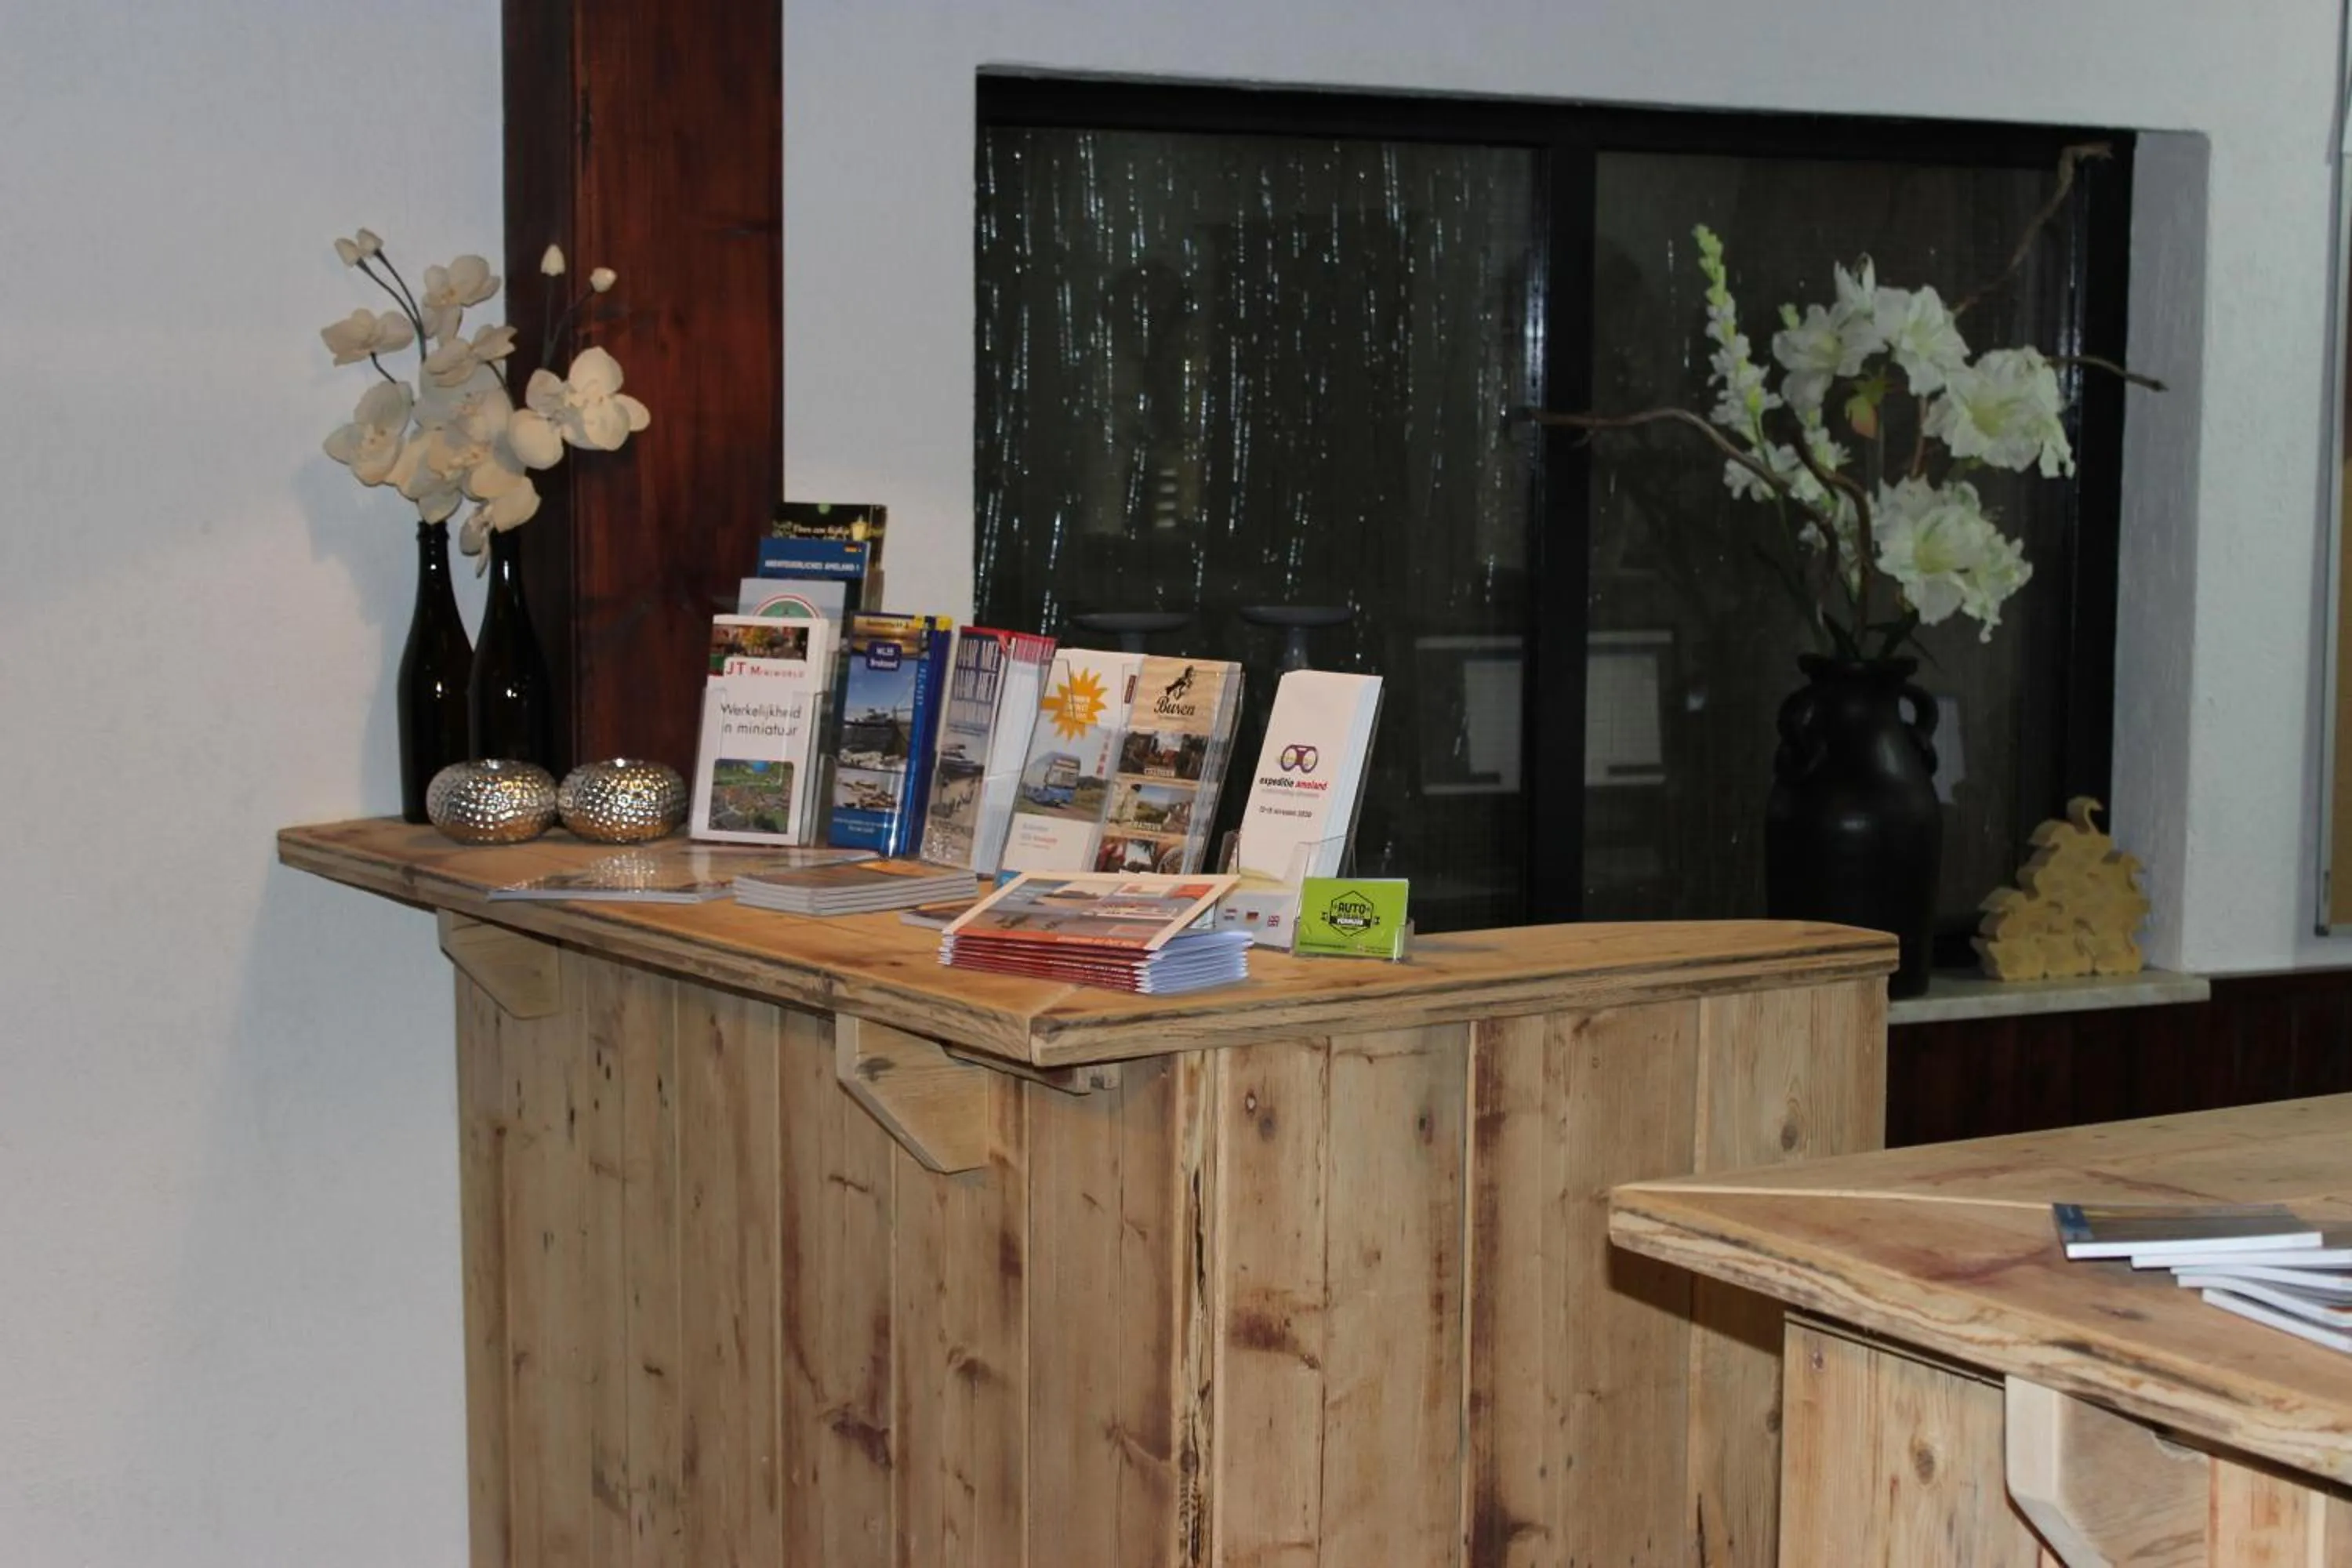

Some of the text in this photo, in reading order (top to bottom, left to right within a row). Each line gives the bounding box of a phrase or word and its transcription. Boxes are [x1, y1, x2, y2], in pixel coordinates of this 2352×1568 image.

[725, 661, 746, 675] JT
[720, 702, 802, 720] Werkelijkheid
[1153, 695, 1196, 716] Buren
[736, 724, 799, 736] miniatuur
[1259, 777, 1328, 791] expeditie ameland
[1338, 902, 1366, 914] AUTO
